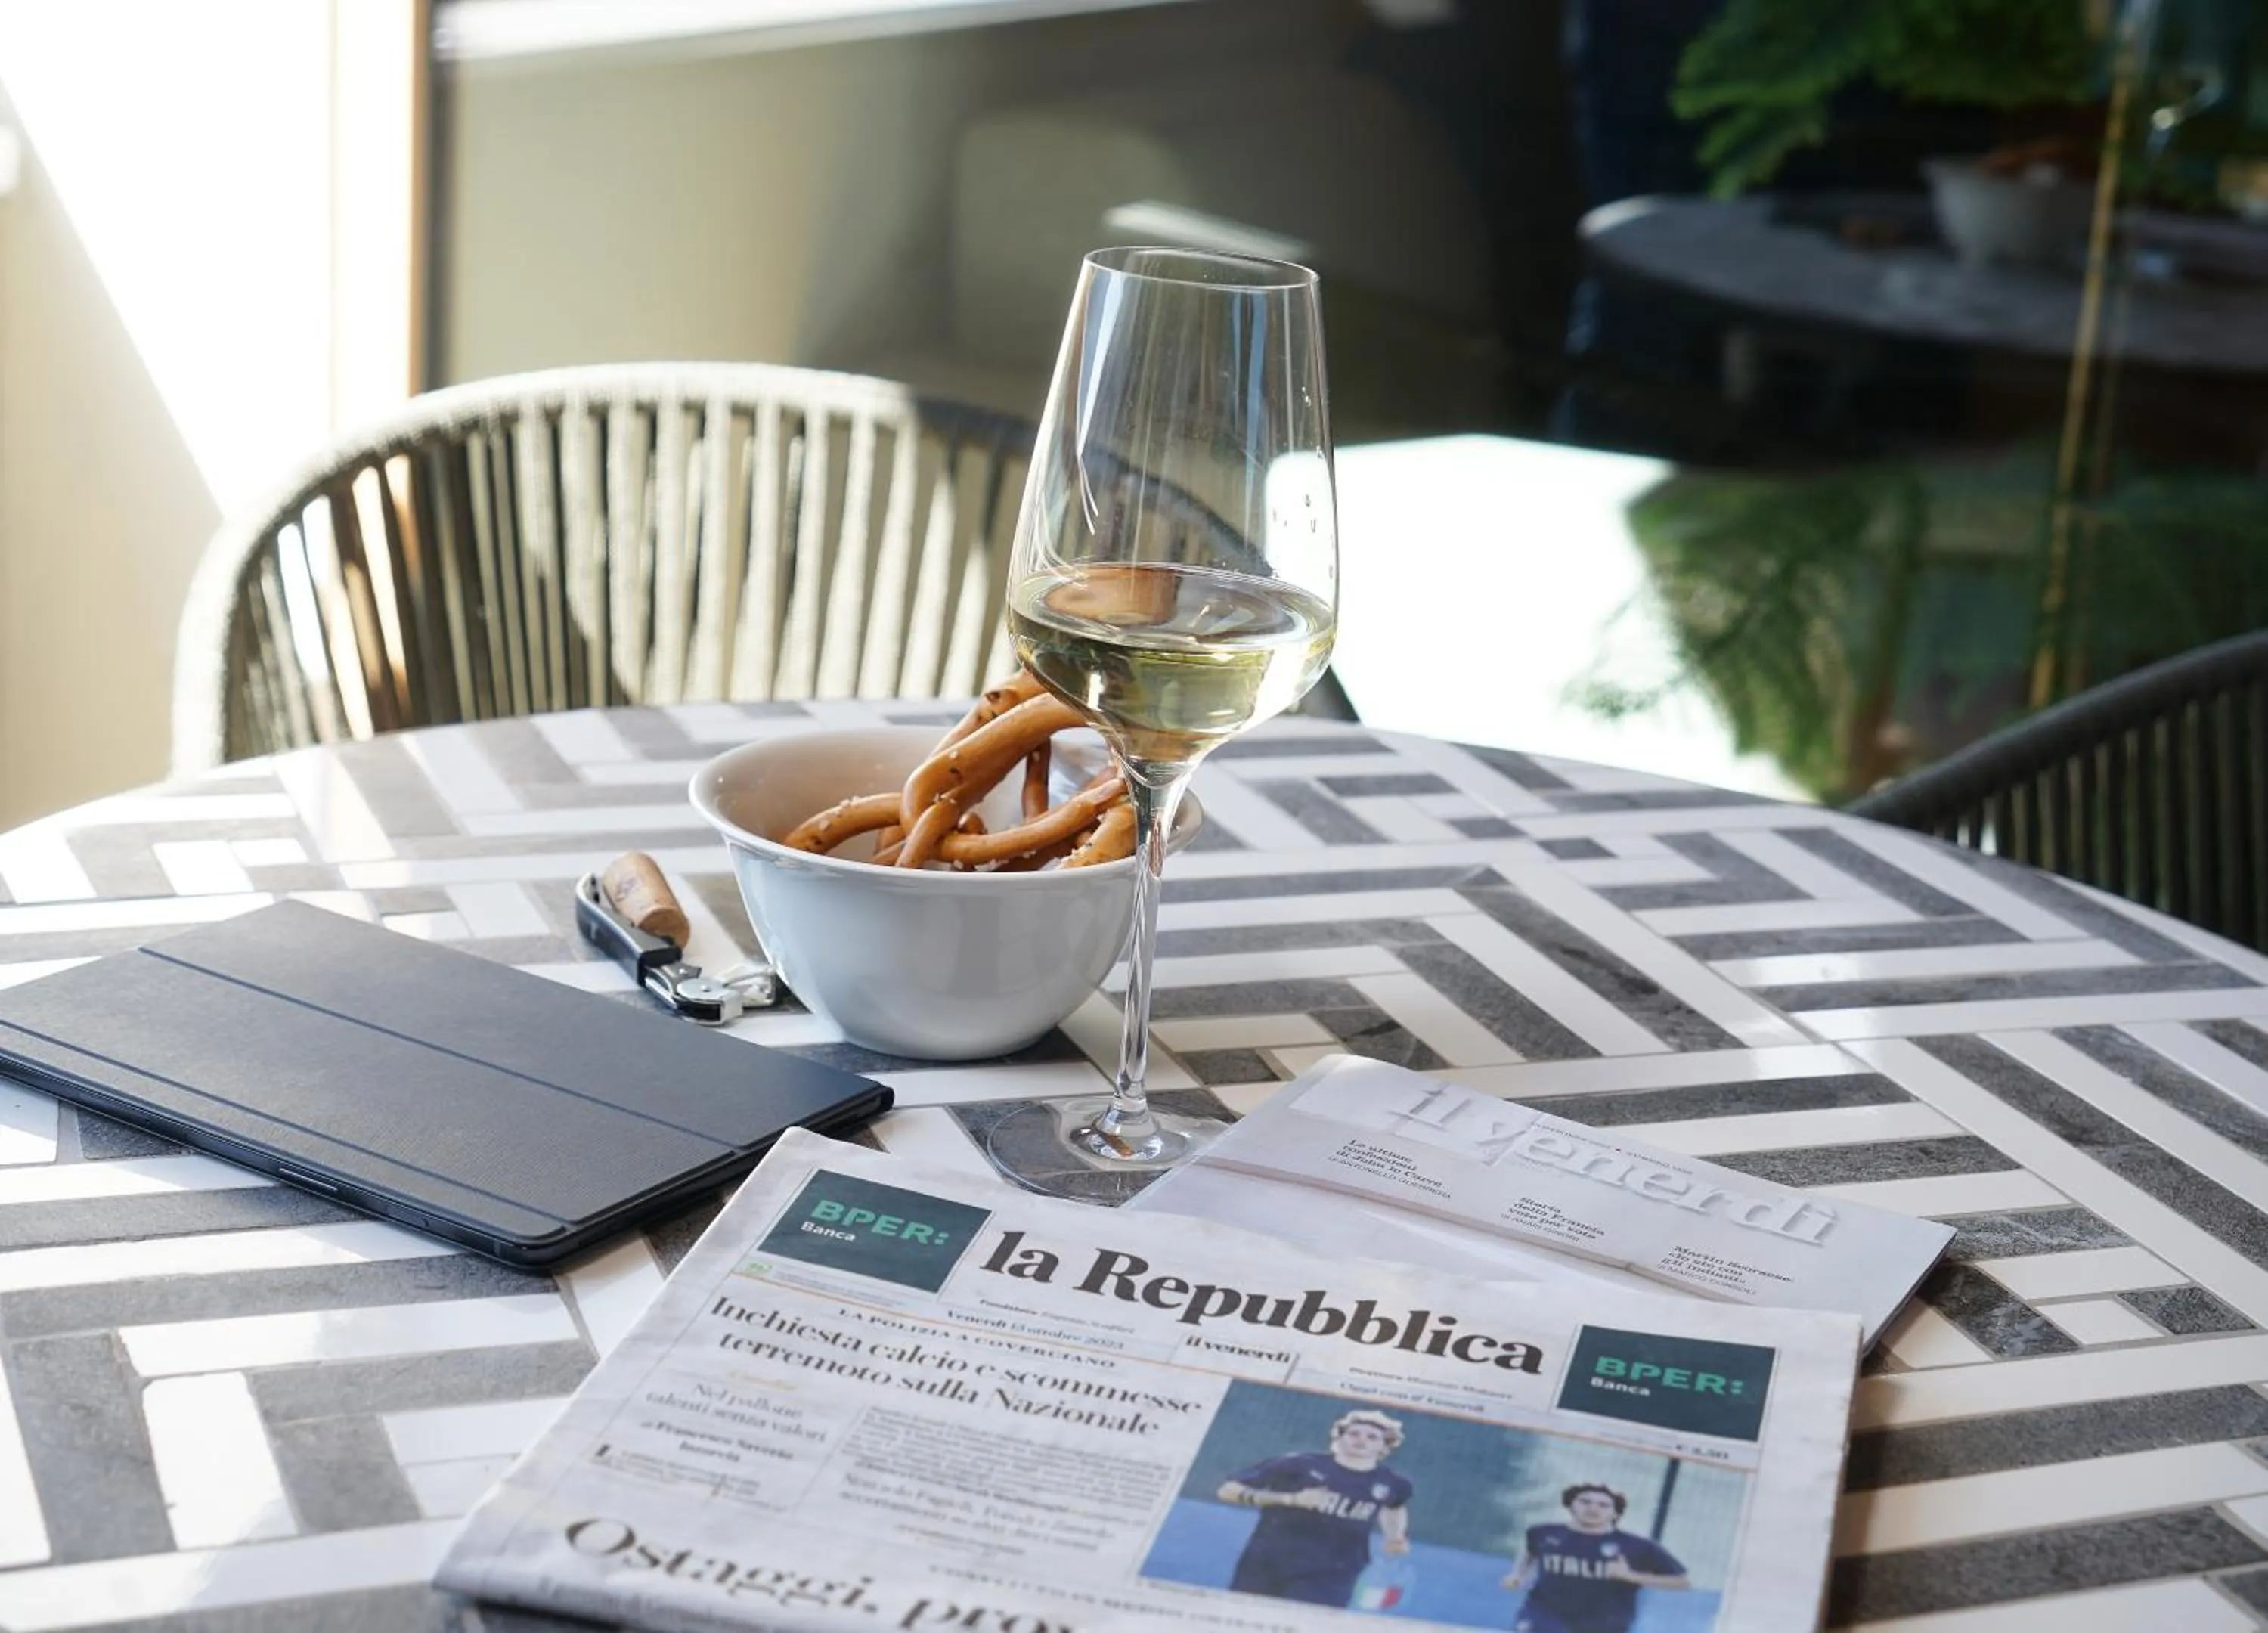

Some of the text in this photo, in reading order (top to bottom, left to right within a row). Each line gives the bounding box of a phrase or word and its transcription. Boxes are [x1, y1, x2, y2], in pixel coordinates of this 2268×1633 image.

[800, 1220, 857, 1242] Banca
[810, 1199, 950, 1246] BPER:
[979, 1229, 1546, 1376] la Repubblica
[711, 1296, 1203, 1415] Inchiesta calcio e scommesse
[1594, 1355, 1744, 1396] BPER:
[718, 1332, 893, 1386] terremoto
[897, 1376, 980, 1405] sulla
[984, 1387, 1160, 1436] Nazionale
[1590, 1376, 1652, 1397] Banca
[1542, 1554, 1605, 1579] ITALI
[898, 1597, 1074, 1633] pro
